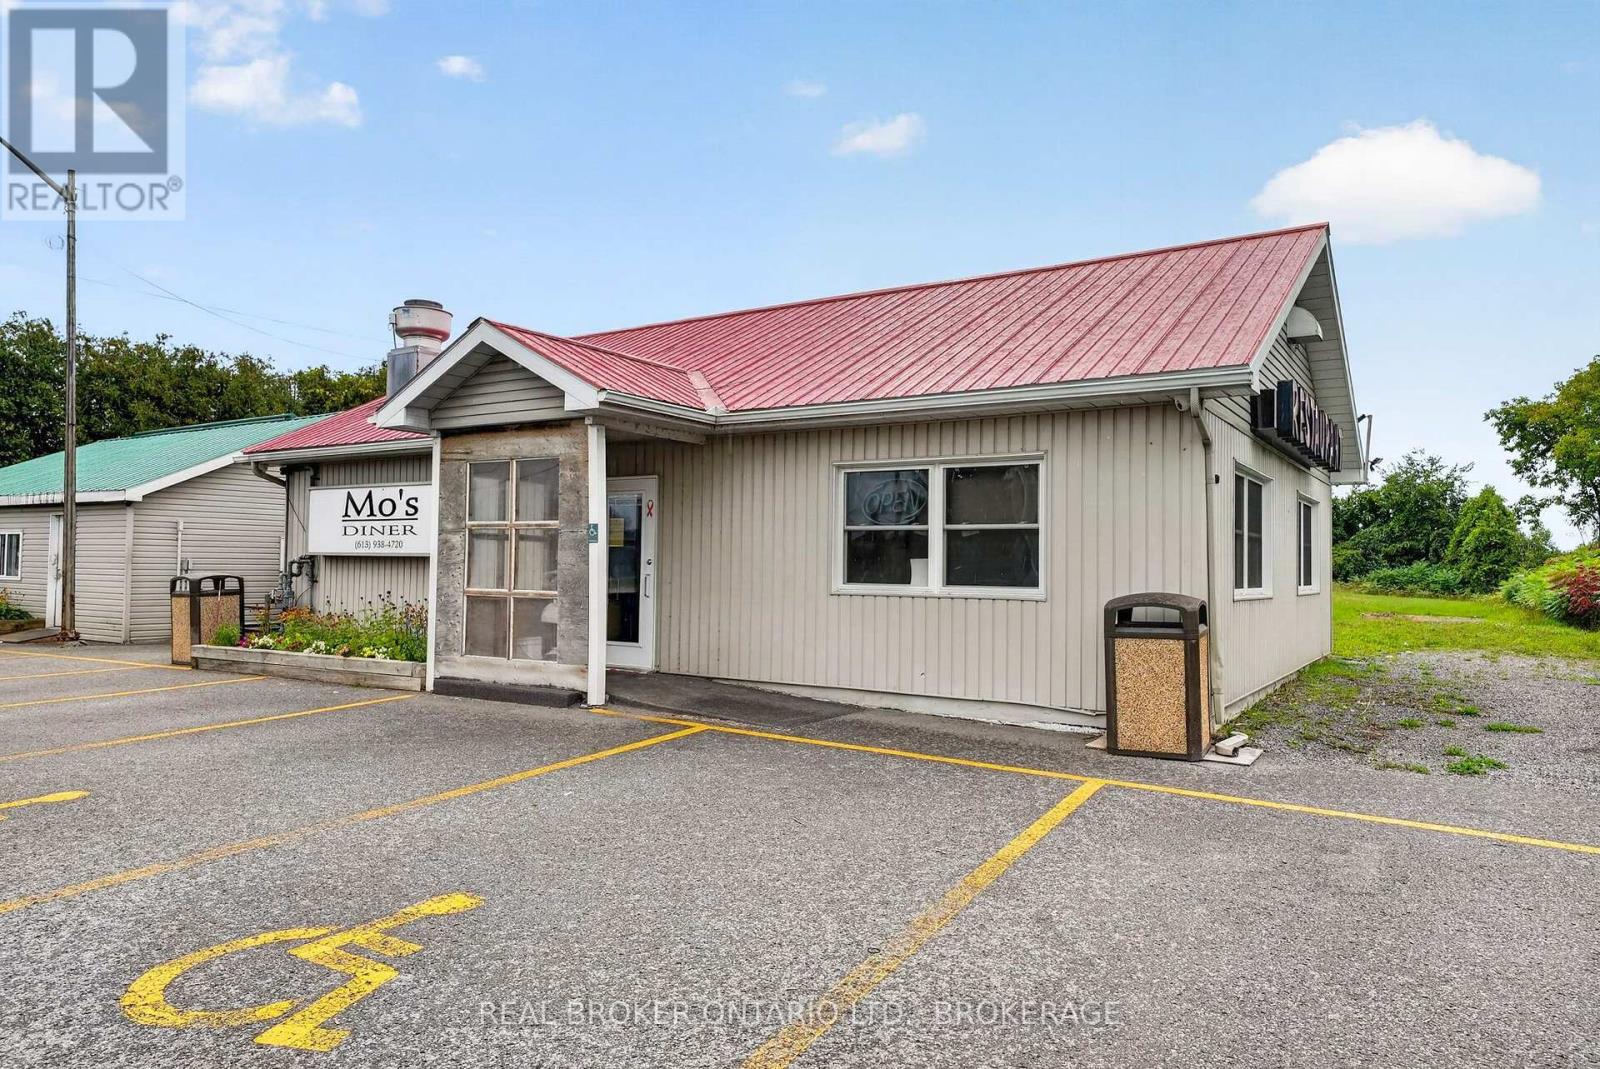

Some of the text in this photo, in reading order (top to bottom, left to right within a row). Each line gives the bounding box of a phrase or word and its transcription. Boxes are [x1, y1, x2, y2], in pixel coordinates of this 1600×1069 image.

[342, 488, 418, 518] Mo's
[866, 490, 920, 514] OPEN
[342, 524, 418, 537] DINER
[354, 539, 404, 550] (613) 938-4720
